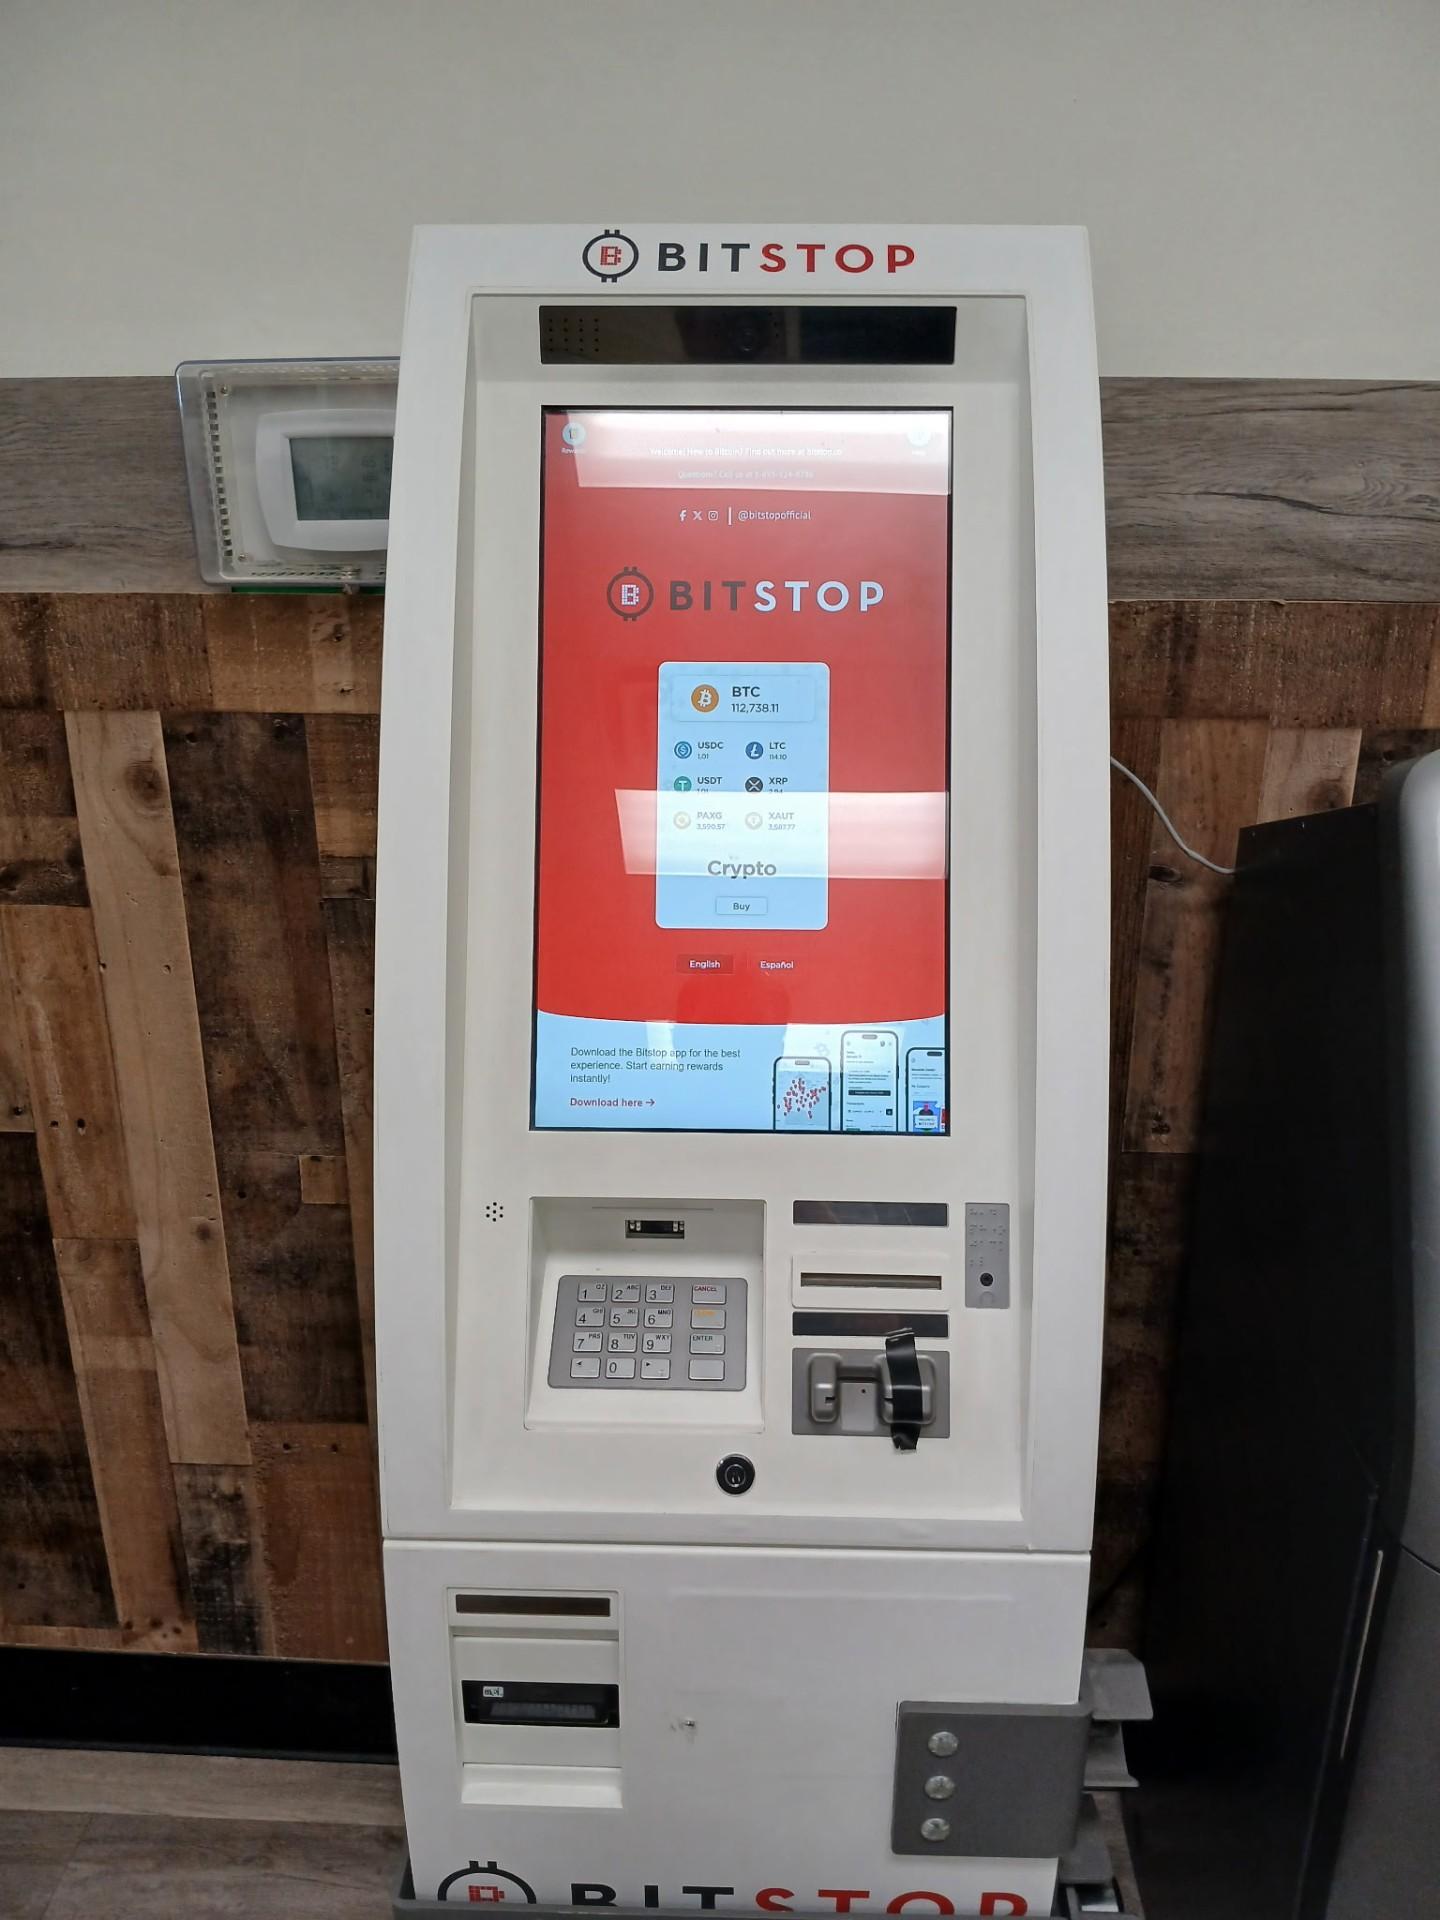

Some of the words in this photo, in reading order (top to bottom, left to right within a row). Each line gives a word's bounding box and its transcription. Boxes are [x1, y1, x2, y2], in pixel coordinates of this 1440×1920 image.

[658, 242, 915, 273] BITSTOP
[738, 510, 811, 522] @bitstopofficial
[670, 580, 884, 612] BITSTOP
[732, 686, 760, 697] BTC
[732, 703, 779, 713] 112,738.11
[697, 741, 724, 749] USDC
[769, 742, 786, 750] LTC
[697, 776, 722, 784] USDT
[769, 777, 788, 785] XRP
[697, 811, 722, 820] PAXG
[768, 812, 794, 820] XAUT
[708, 860, 777, 879] Crypto
[733, 902, 750, 912] Buy
[689, 960, 720, 969] English
[760, 960, 793, 970] Español
[571, 1047, 616, 1057] Download
[619, 1047, 633, 1057] the
[636, 1047, 667, 1058] Bitstop
[669, 1049, 686, 1059] app
[689, 1048, 701, 1057] for
[704, 1048, 718, 1058] the
[721, 1048, 741, 1058] best
[571, 1061, 623, 1072] experience.
[626, 1061, 647, 1071] Start
[650, 1062, 684, 1073] earning
[686, 1062, 723, 1071] rewards
[570, 1097, 619, 1107] Download
[621, 1098, 643, 1107] here
[583, 1289, 588, 1299] 1
[614, 1289, 623, 1299] 2
[649, 1289, 657, 1300] 3
[578, 1313, 586, 1324] 4
[613, 1314, 621, 1324] 5
[647, 1314, 656, 1325] 6
[577, 1338, 585, 1349] 7
[611, 1339, 619, 1350] 8
[646, 1340, 654, 1350] 9
[609, 1362, 617, 1373] 0
